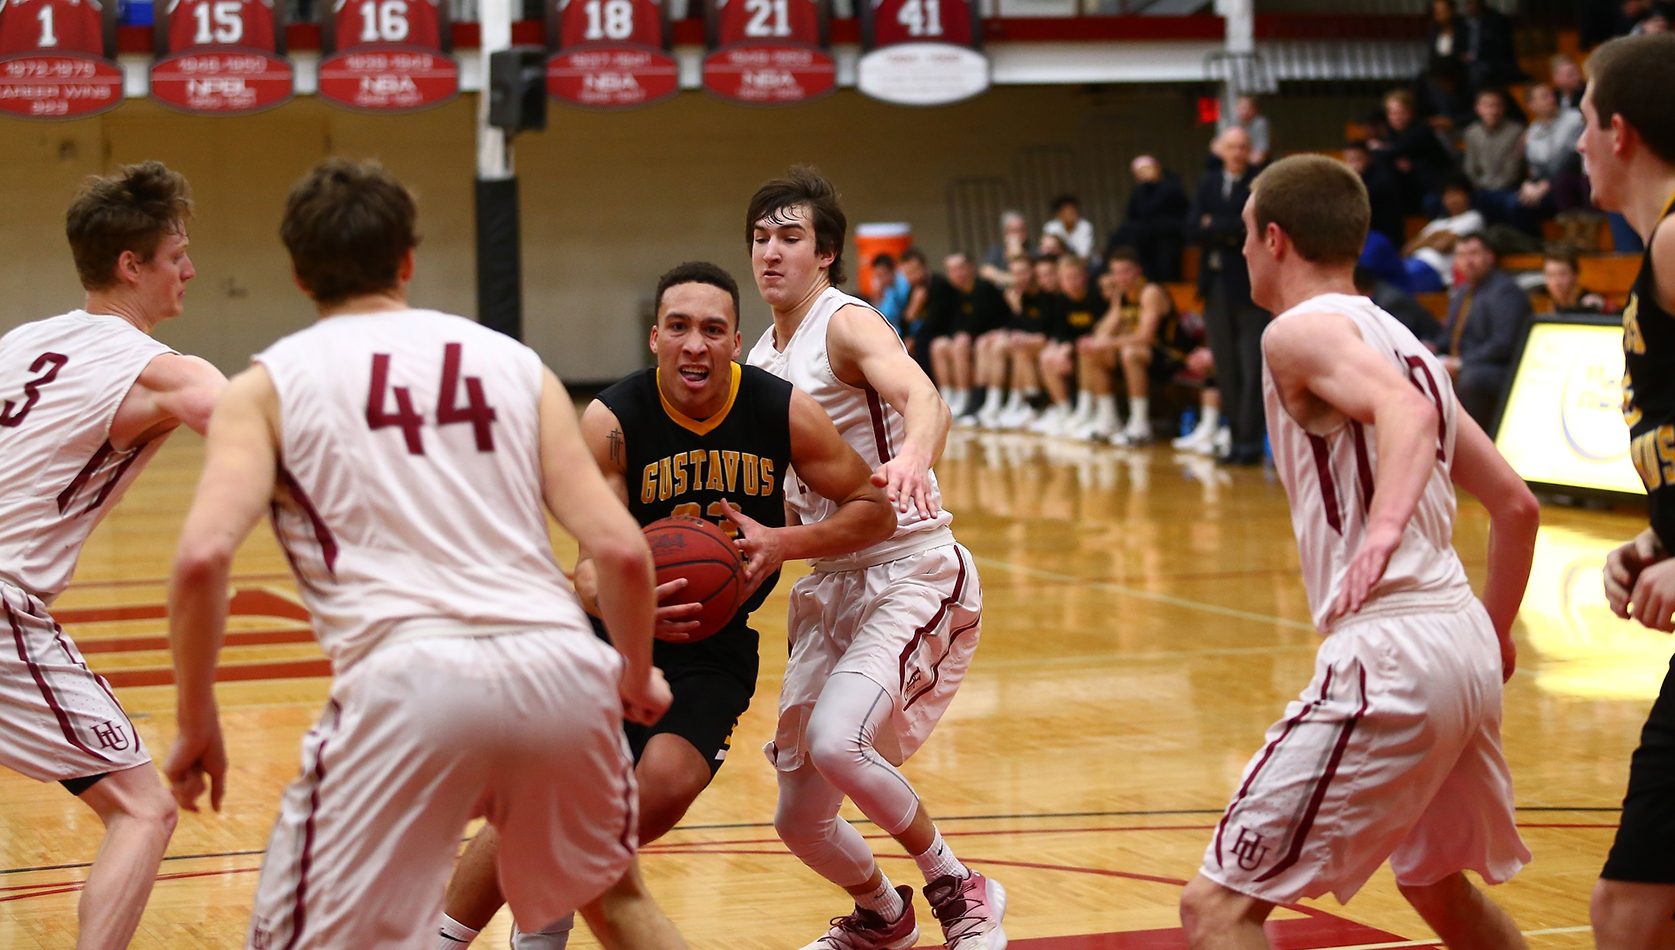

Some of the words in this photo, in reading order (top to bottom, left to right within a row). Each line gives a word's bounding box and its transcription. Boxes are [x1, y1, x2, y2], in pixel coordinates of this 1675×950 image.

[37, 4, 58, 48] 1
[193, 1, 244, 45] 15
[359, 1, 410, 42] 16
[584, 0, 634, 40] 18
[744, 0, 792, 37] 21
[897, 0, 942, 36] 41
[360, 74, 418, 95] NBA
[583, 71, 640, 92] NBA
[741, 69, 799, 90] NBA
[0, 351, 69, 428] 3
[365, 342, 497, 456] 44
[640, 449, 775, 504] GUSTAVUS
[90, 719, 131, 751] HU
[1230, 825, 1271, 872] HU
